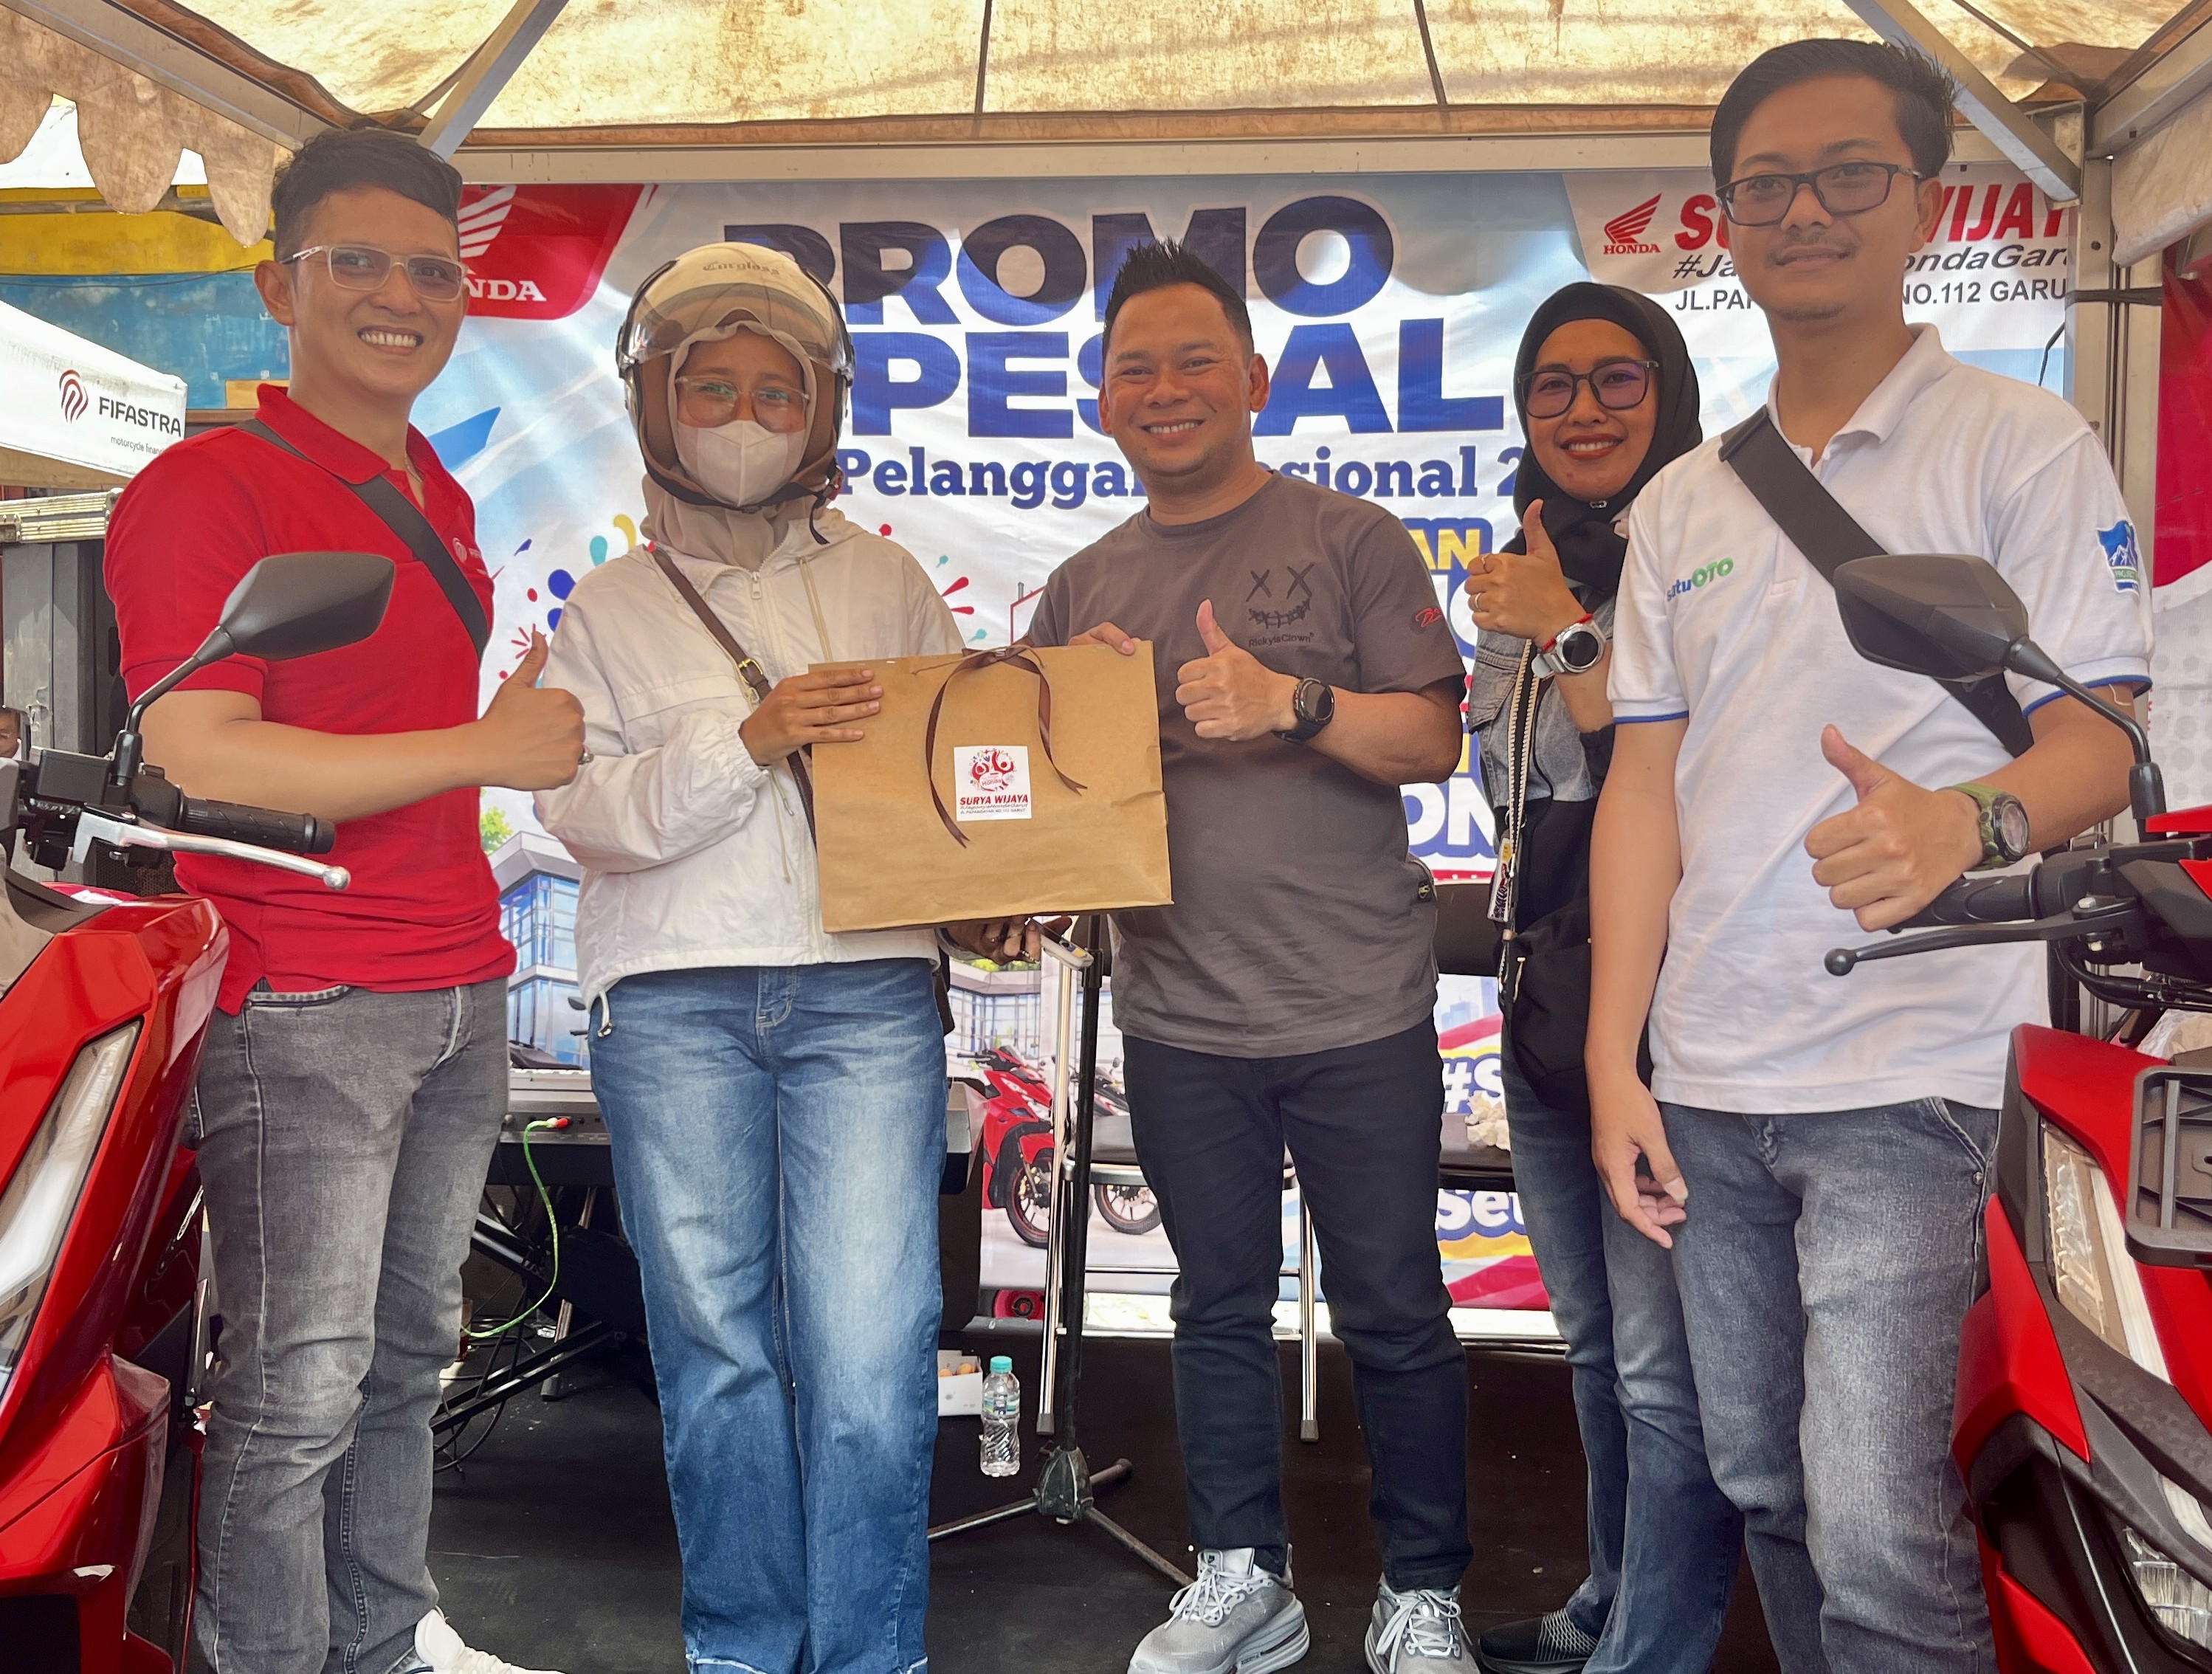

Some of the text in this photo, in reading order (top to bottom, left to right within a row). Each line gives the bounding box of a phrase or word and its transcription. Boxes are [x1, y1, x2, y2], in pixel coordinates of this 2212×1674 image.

[1926, 182, 2067, 243] IJAY
[1603, 244, 1661, 255] HONDA
[463, 277, 547, 301] NDA
[1675, 289, 1755, 311] JL.PA
[1990, 278, 2067, 302] GARU
[99, 396, 182, 437] FIFASTRA
[959, 794, 1029, 805] SURYA WIJAYA
